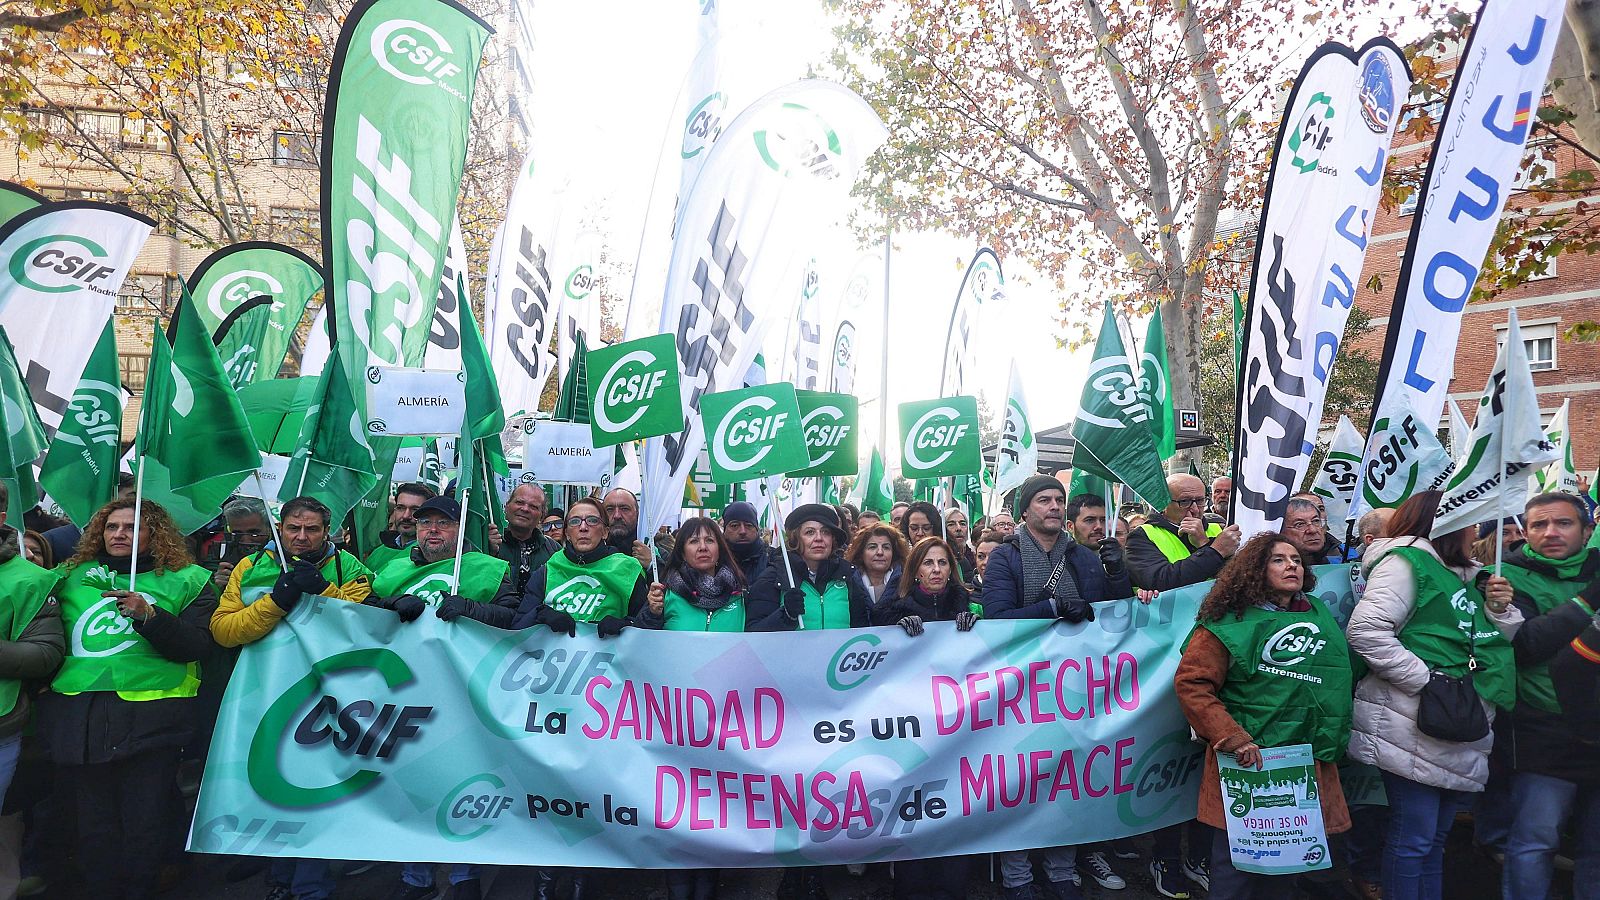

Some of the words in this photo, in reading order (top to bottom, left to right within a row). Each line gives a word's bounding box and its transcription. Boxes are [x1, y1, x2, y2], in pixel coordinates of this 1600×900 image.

[391, 34, 461, 80] CSIF
[438, 79, 467, 101] Madrid
[1317, 163, 1338, 177] adrid
[347, 113, 442, 368] CSIF
[32, 249, 115, 283] CSIF
[506, 224, 551, 380] CSIF
[608, 370, 667, 406] CSIF
[398, 395, 449, 406] ALMERÍA
[728, 412, 788, 447] CSIF
[805, 425, 850, 446] CSIF
[917, 424, 969, 448] CSIF
[81, 449, 100, 476] Madrid
[548, 446, 592, 457] ALMERÍA
[259, 472, 276, 480] MERÍA
[361, 499, 379, 508] Madr
[558, 593, 605, 615] CSIF
[500, 648, 615, 696] CSIF
[839, 650, 888, 673] CSIF
[1258, 663, 1322, 684] Extremadura
[525, 701, 567, 735] La
[581, 675, 785, 751] SANIDAD
[813, 718, 855, 743] es
[871, 715, 921, 740] un
[931, 652, 1140, 736] DERECHO
[294, 695, 434, 758] CSIF
[527, 793, 590, 819] por
[603, 793, 638, 827] la
[654, 765, 874, 832] DEFENSA
[899, 789, 947, 822] de
[959, 737, 1136, 816] MUFACE
[1136, 753, 1202, 798] CSIF
[451, 794, 514, 820] CSIF
[1243, 817, 1275, 829] JUEGA
[1279, 816, 1291, 827] SE
[1294, 815, 1308, 827] NO
[196, 814, 306, 854] SIF
[1253, 838, 1265, 846] de
[1267, 837, 1291, 846] salud
[1292, 837, 1300, 845] la
[1302, 851, 1322, 861] CSIF
